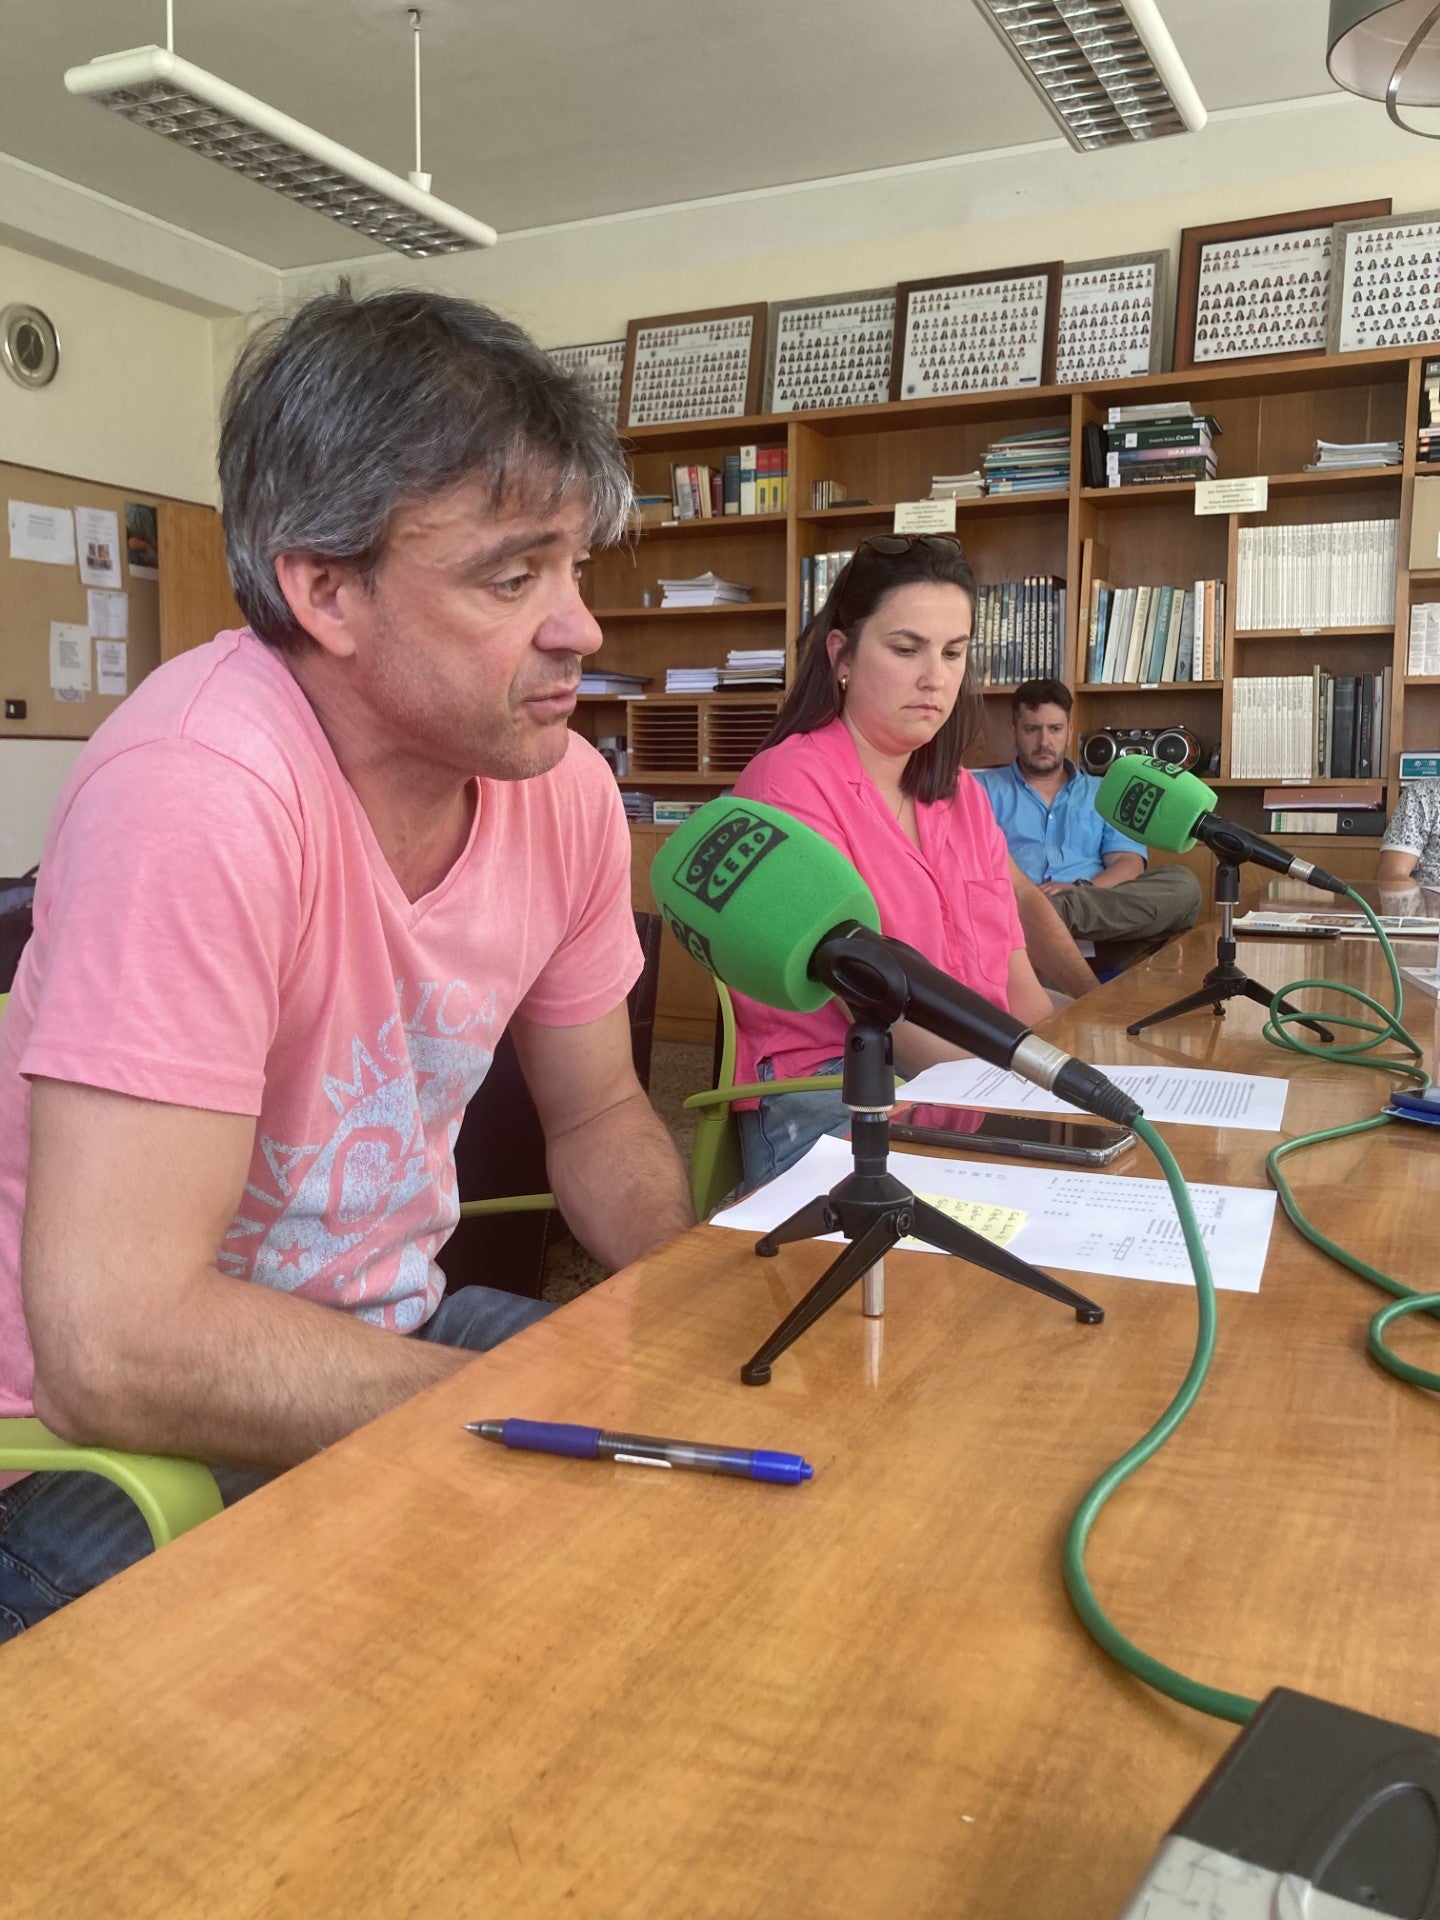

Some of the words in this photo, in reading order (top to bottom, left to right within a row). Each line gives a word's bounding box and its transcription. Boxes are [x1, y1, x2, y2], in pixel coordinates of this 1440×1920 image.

[978, 597, 986, 643] REMBRANDT
[1122, 784, 1141, 818] ONDA
[1135, 791, 1155, 823] CERO
[690, 822, 744, 877] ONDA
[713, 832, 765, 887] CERO
[321, 978, 497, 1117] MOICA
